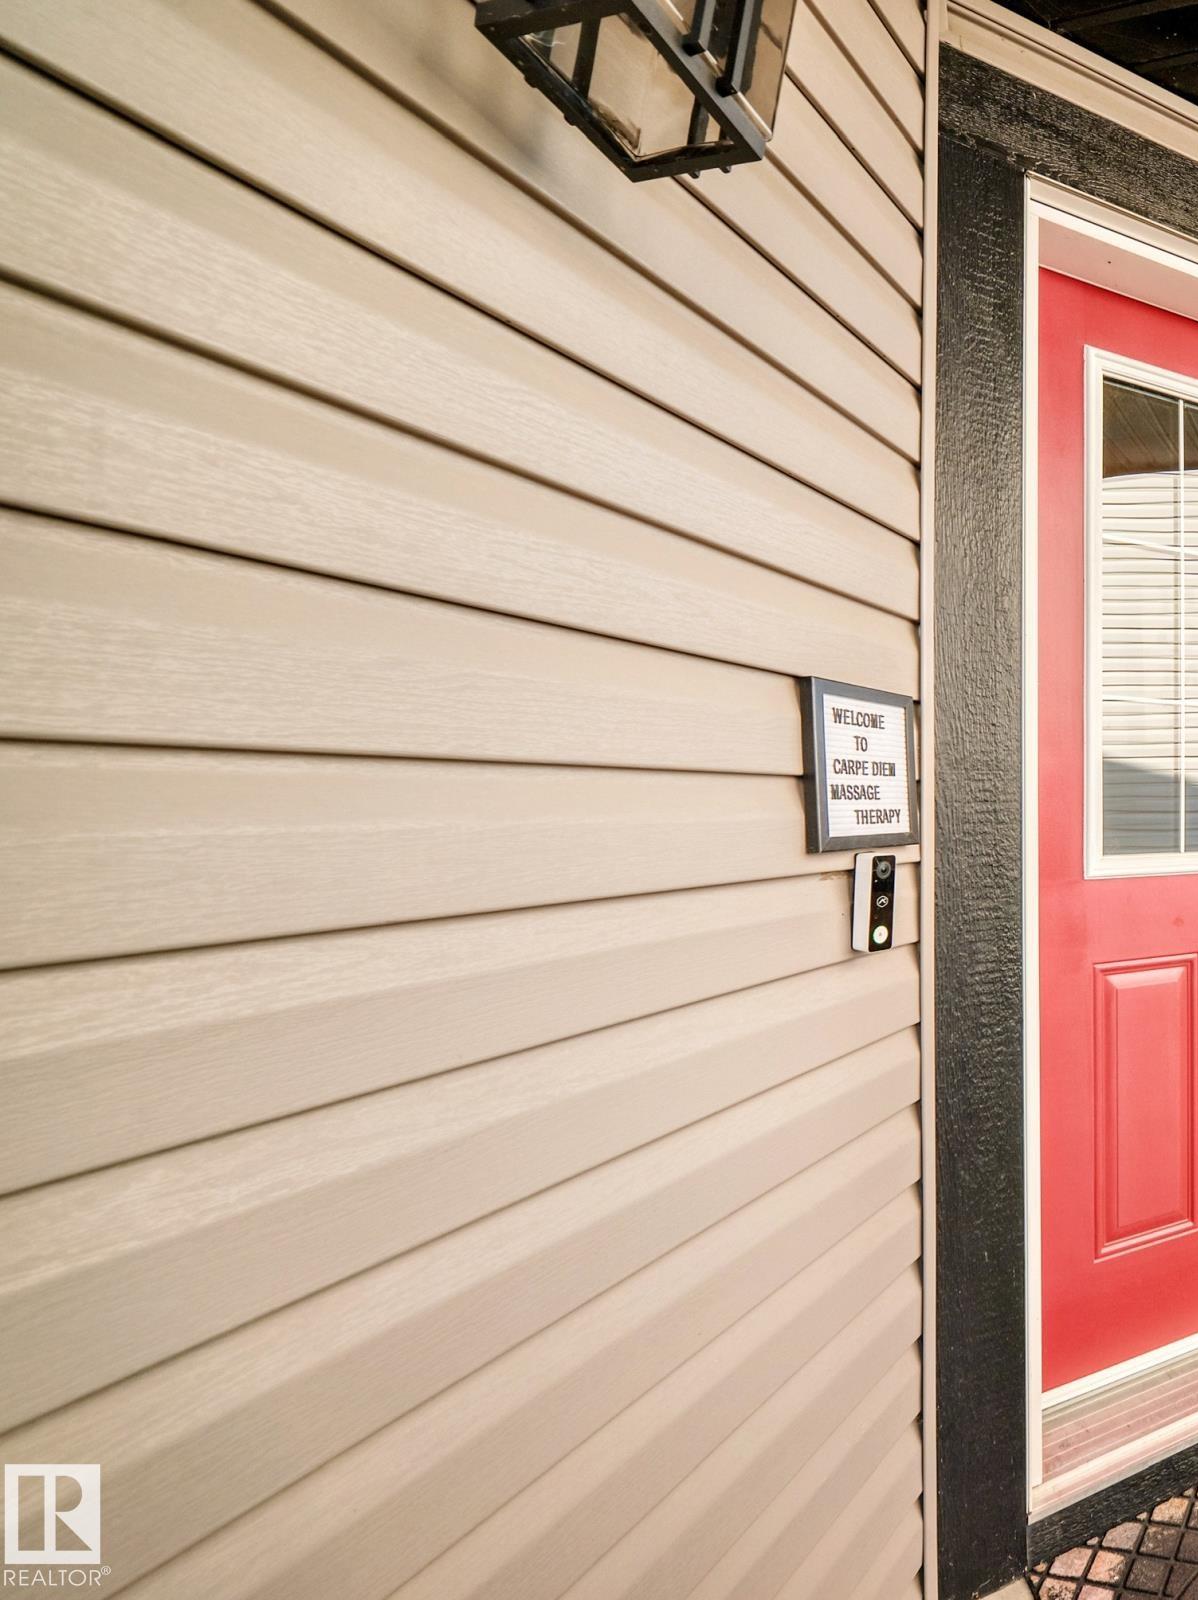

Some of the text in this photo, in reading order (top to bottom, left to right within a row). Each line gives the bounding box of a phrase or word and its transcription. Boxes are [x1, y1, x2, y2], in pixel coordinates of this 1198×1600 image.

[832, 706, 885, 729] WELCOME
[853, 735, 868, 752] TO
[833, 758, 896, 777] CARPE DIEM
[830, 783, 881, 801] MASSAGE
[854, 808, 901, 825] THERAPY
